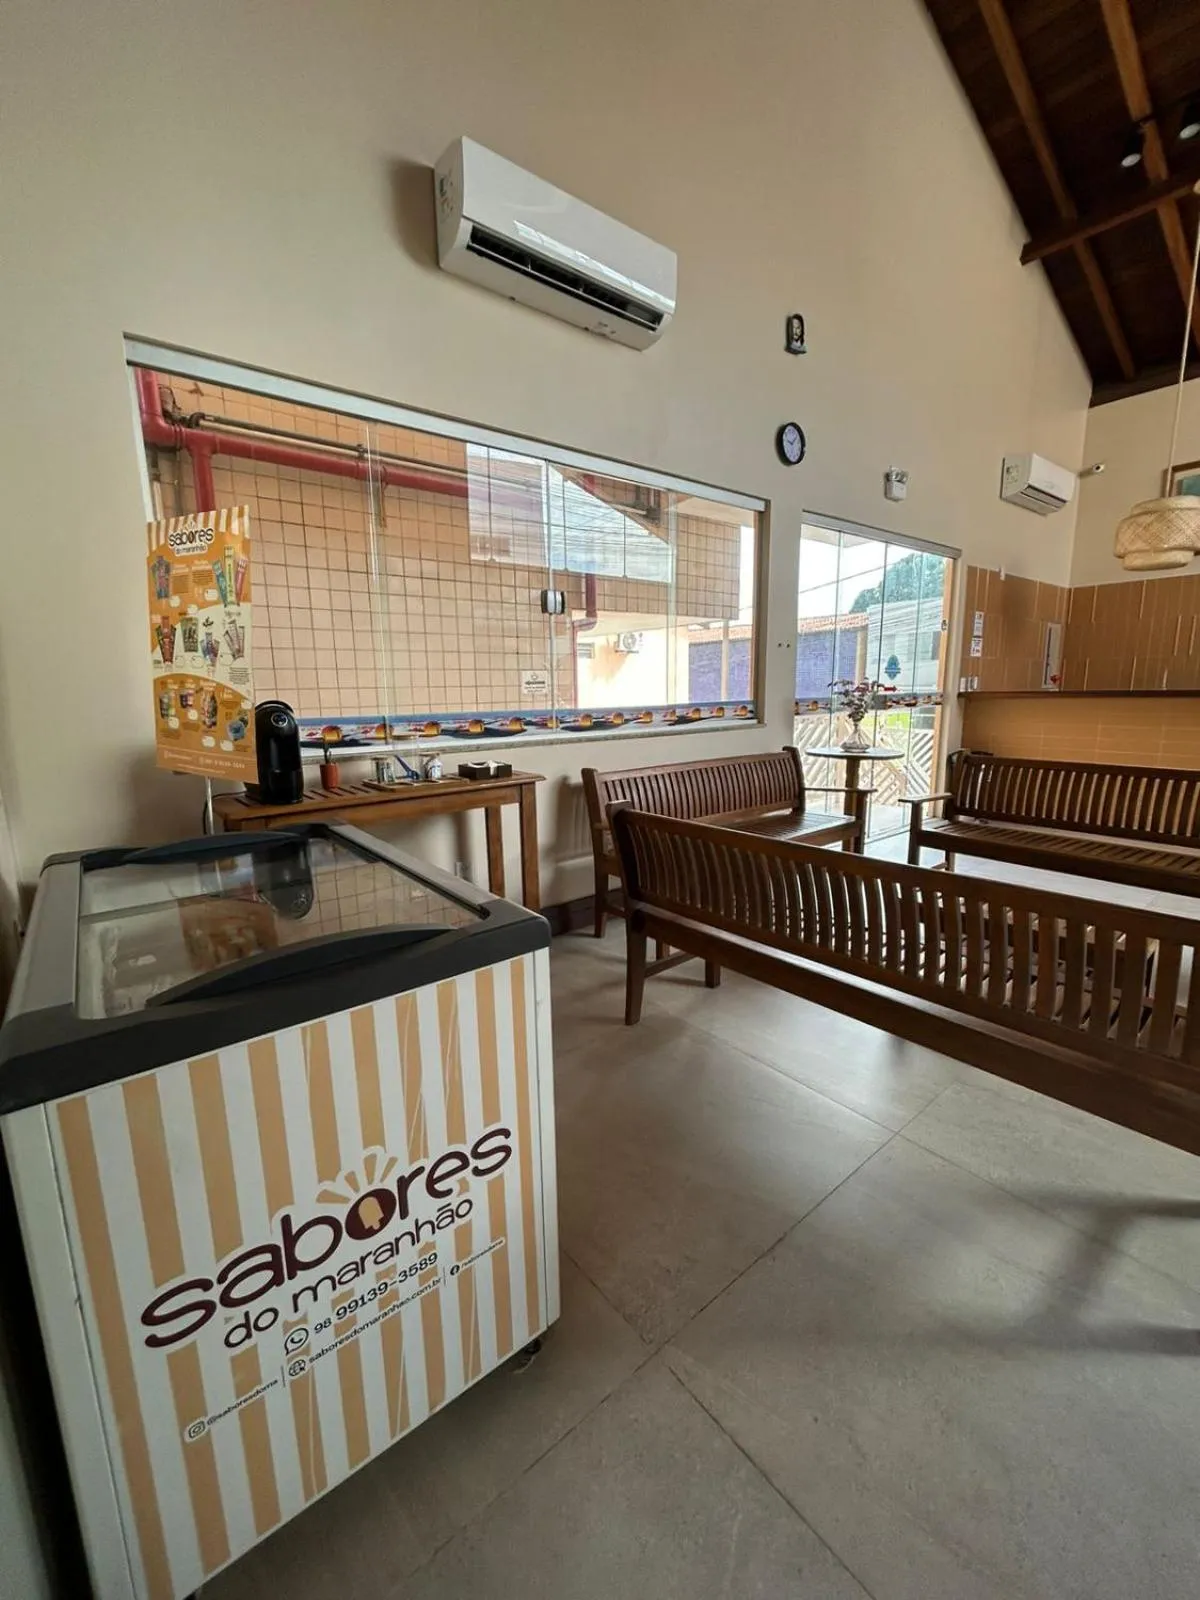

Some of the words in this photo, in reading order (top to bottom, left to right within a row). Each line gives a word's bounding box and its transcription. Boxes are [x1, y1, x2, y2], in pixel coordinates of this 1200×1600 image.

[169, 528, 214, 547] sabores
[140, 1127, 512, 1348] sabores
[223, 1307, 279, 1349] do
[292, 1198, 474, 1313] maranhão
[314, 1317, 332, 1334] 98
[336, 1252, 438, 1320] 99139-3589
